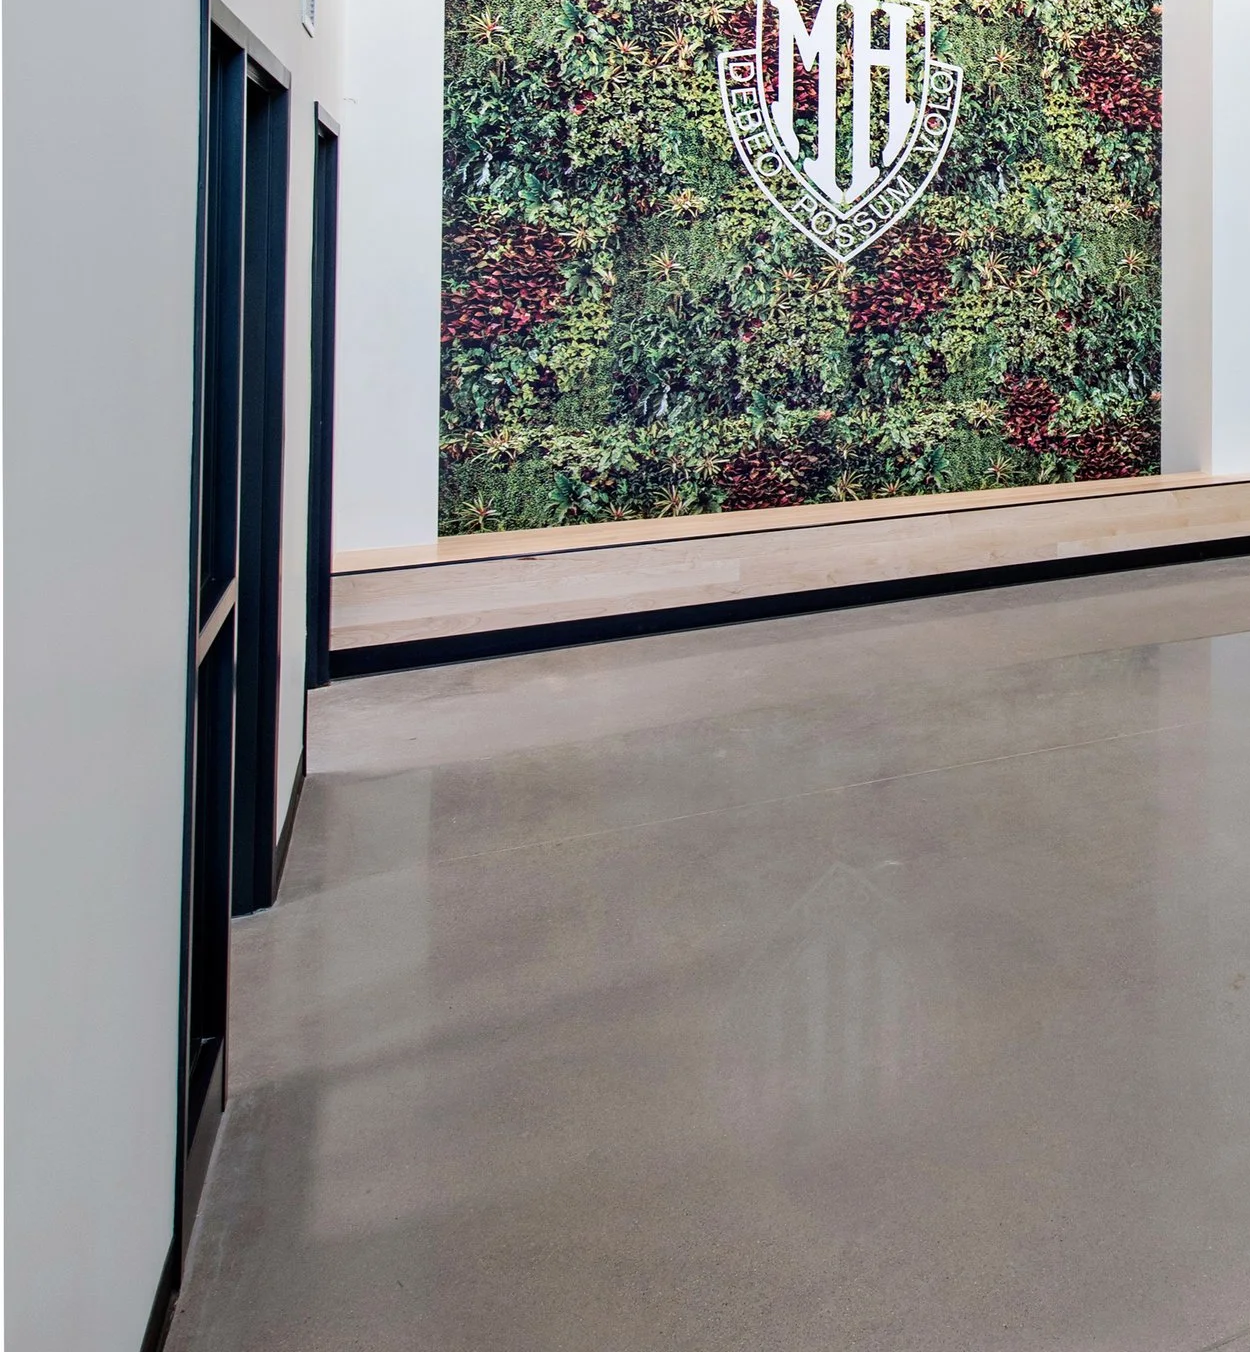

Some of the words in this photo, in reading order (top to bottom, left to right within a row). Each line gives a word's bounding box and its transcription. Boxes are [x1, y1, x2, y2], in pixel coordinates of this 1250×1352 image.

[728, 61, 783, 178] DEBEO
[791, 174, 916, 248] POSSUM
[915, 69, 954, 155] VOLO
